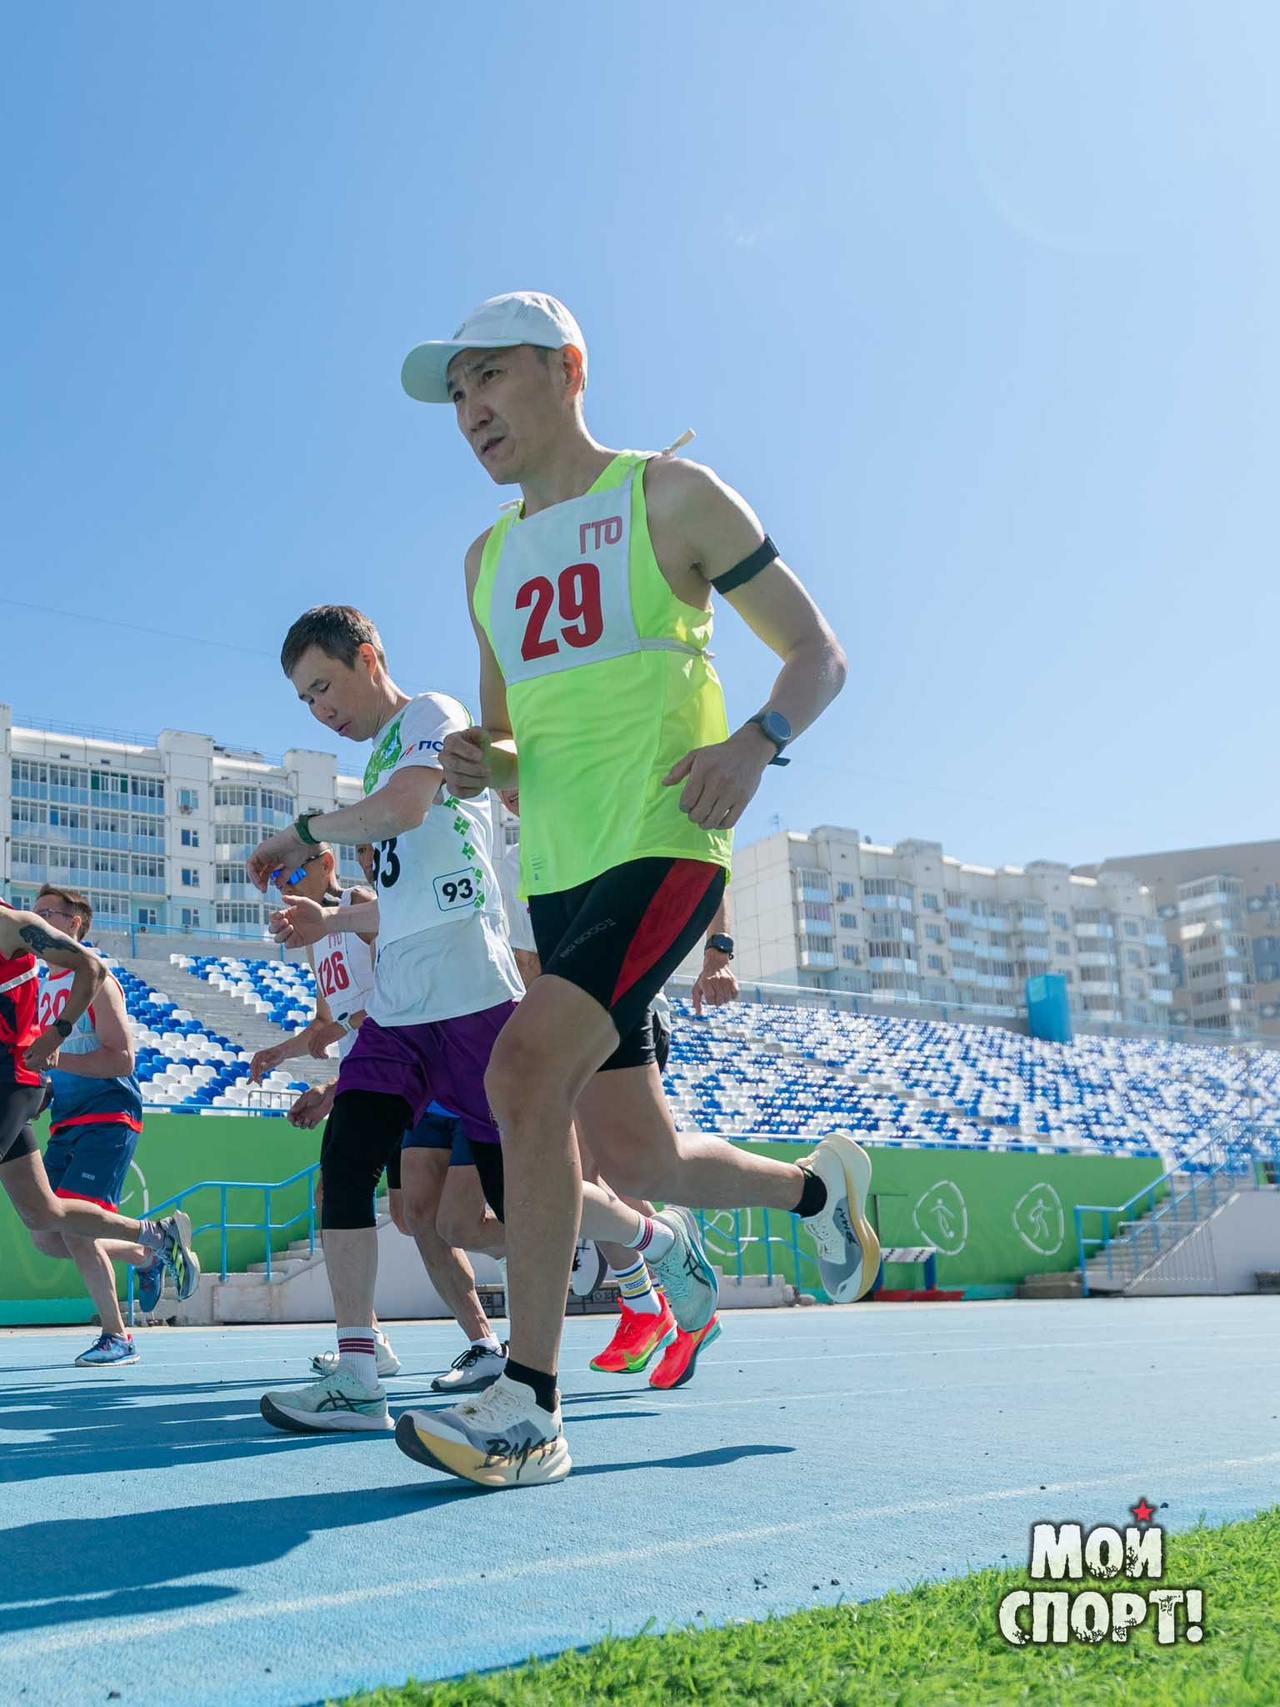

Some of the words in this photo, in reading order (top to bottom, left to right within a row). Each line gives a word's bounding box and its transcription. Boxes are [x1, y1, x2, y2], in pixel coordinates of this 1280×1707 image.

[579, 515, 623, 554] ГТО
[515, 563, 604, 661] 29
[442, 878, 474, 903] 93
[318, 951, 350, 998] 126
